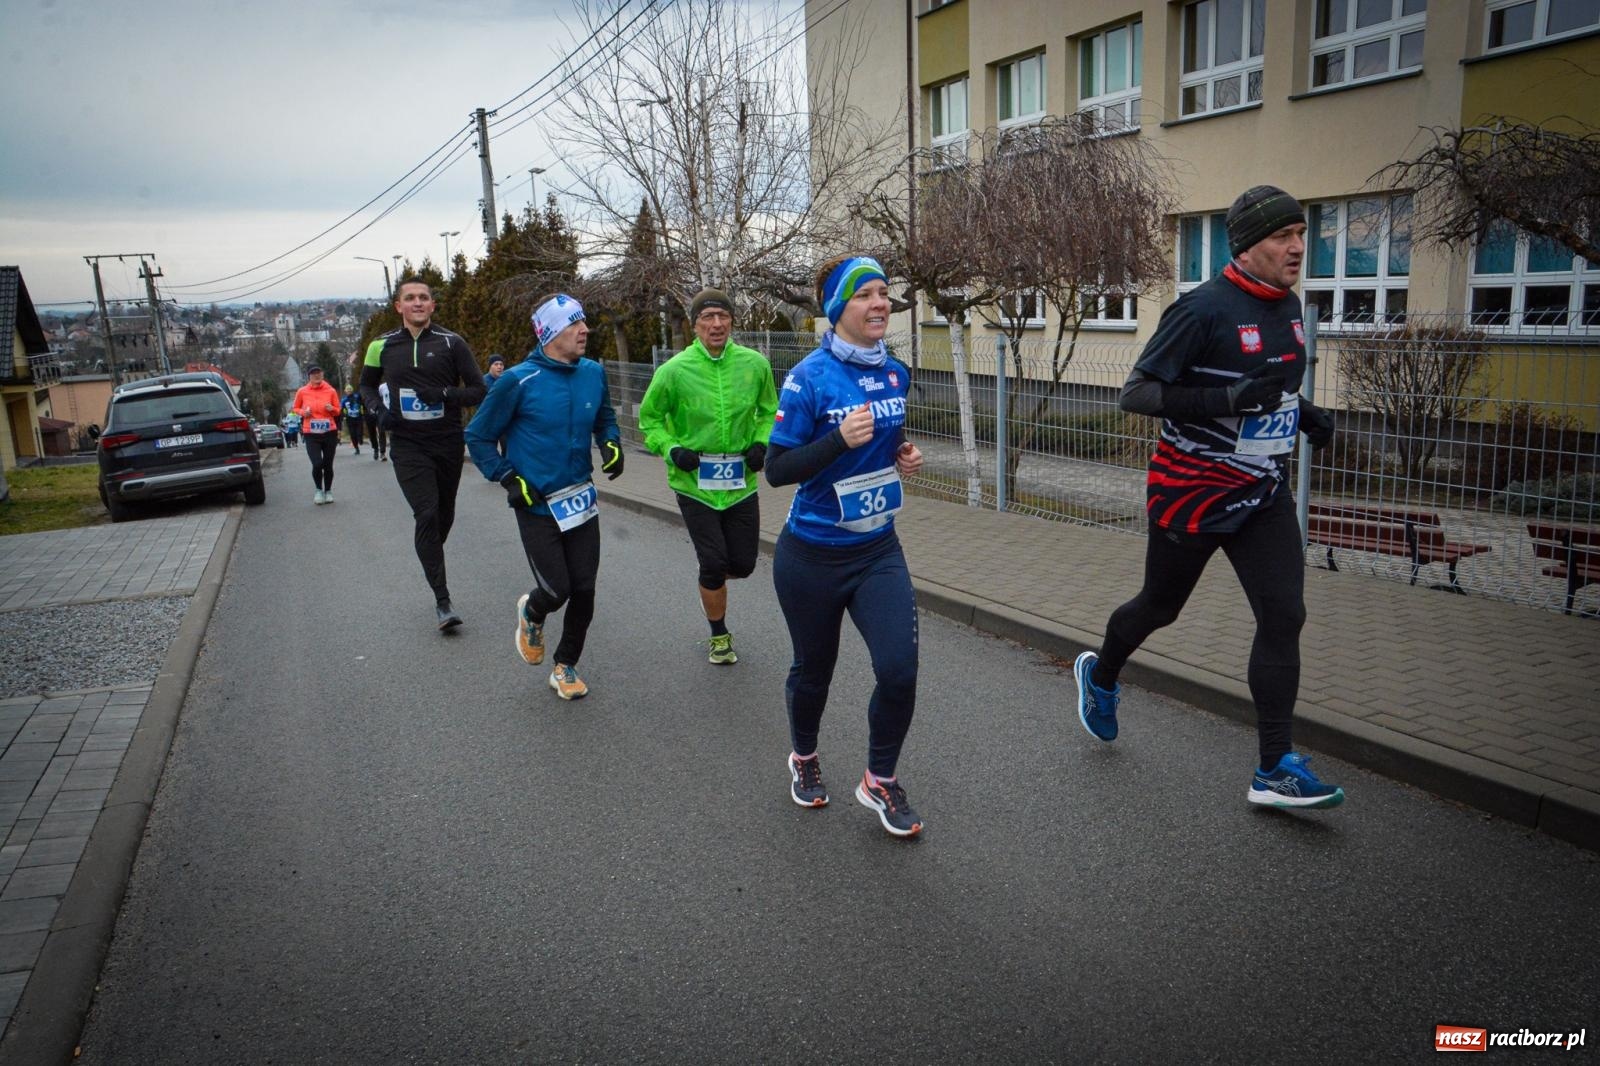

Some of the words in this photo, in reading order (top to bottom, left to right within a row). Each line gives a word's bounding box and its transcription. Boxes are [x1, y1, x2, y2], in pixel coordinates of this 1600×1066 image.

[1253, 411, 1295, 438] 229
[712, 463, 734, 479] 26
[560, 490, 592, 516] 107
[859, 487, 887, 516] 36
